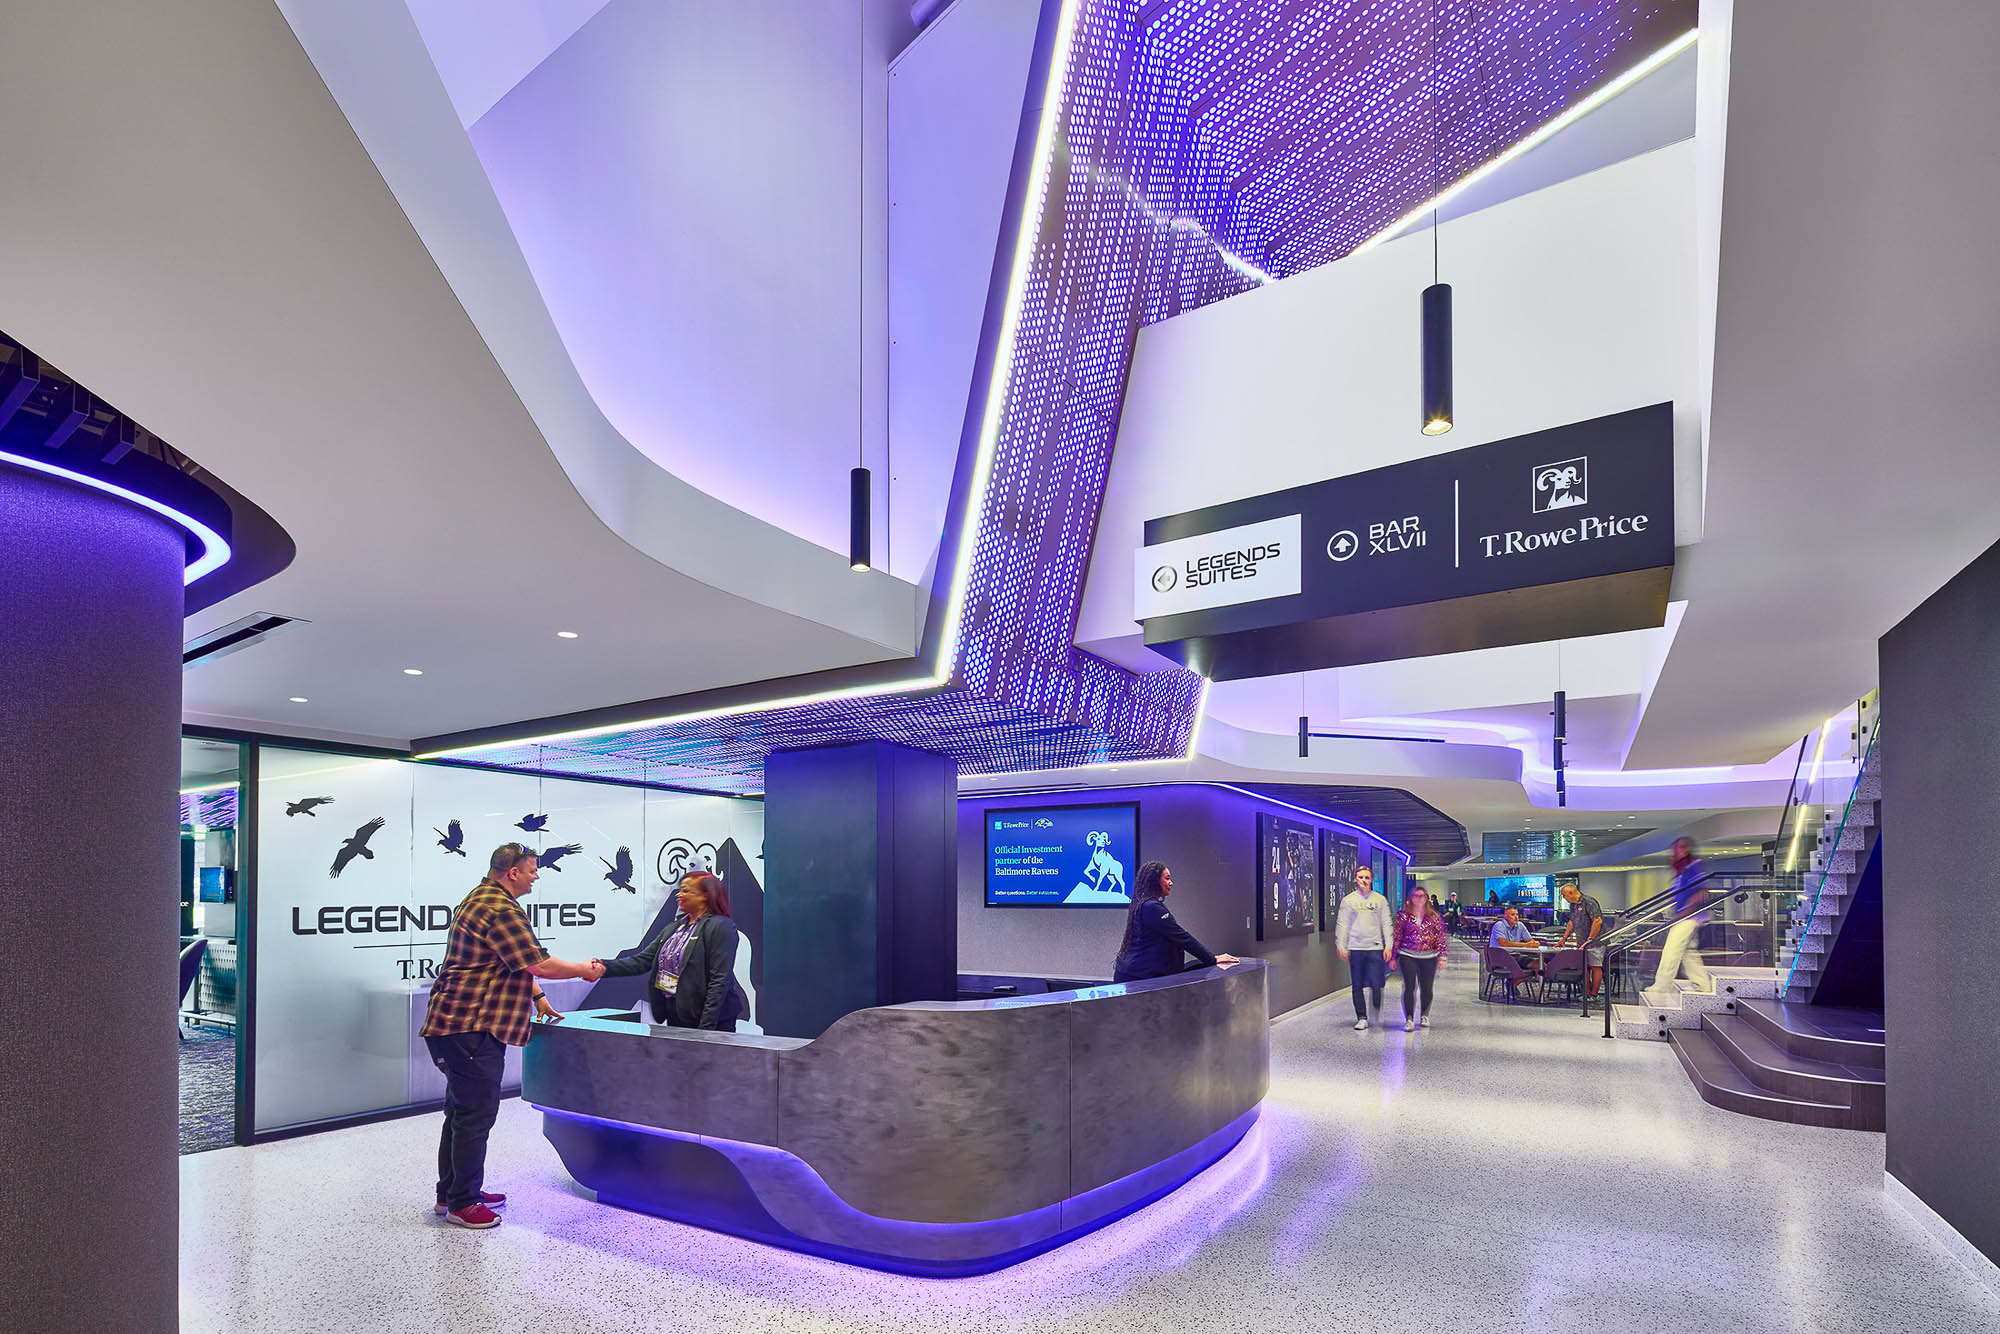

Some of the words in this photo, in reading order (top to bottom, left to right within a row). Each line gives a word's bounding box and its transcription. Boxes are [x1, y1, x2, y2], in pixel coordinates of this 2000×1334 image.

[1369, 515, 1420, 540] BAR
[1369, 530, 1426, 556] XLVII
[1185, 542, 1281, 574] LEGENDS
[1185, 562, 1257, 589] SUITES
[994, 845, 1020, 854] Official
[994, 857, 1021, 866] partner
[1022, 856, 1031, 864] of
[1031, 856, 1043, 864] the
[1271, 846, 1280, 873] 24
[994, 867, 1030, 876] Baltimore
[1031, 867, 1059, 875] Ravens
[292, 905, 459, 935] LEGEND
